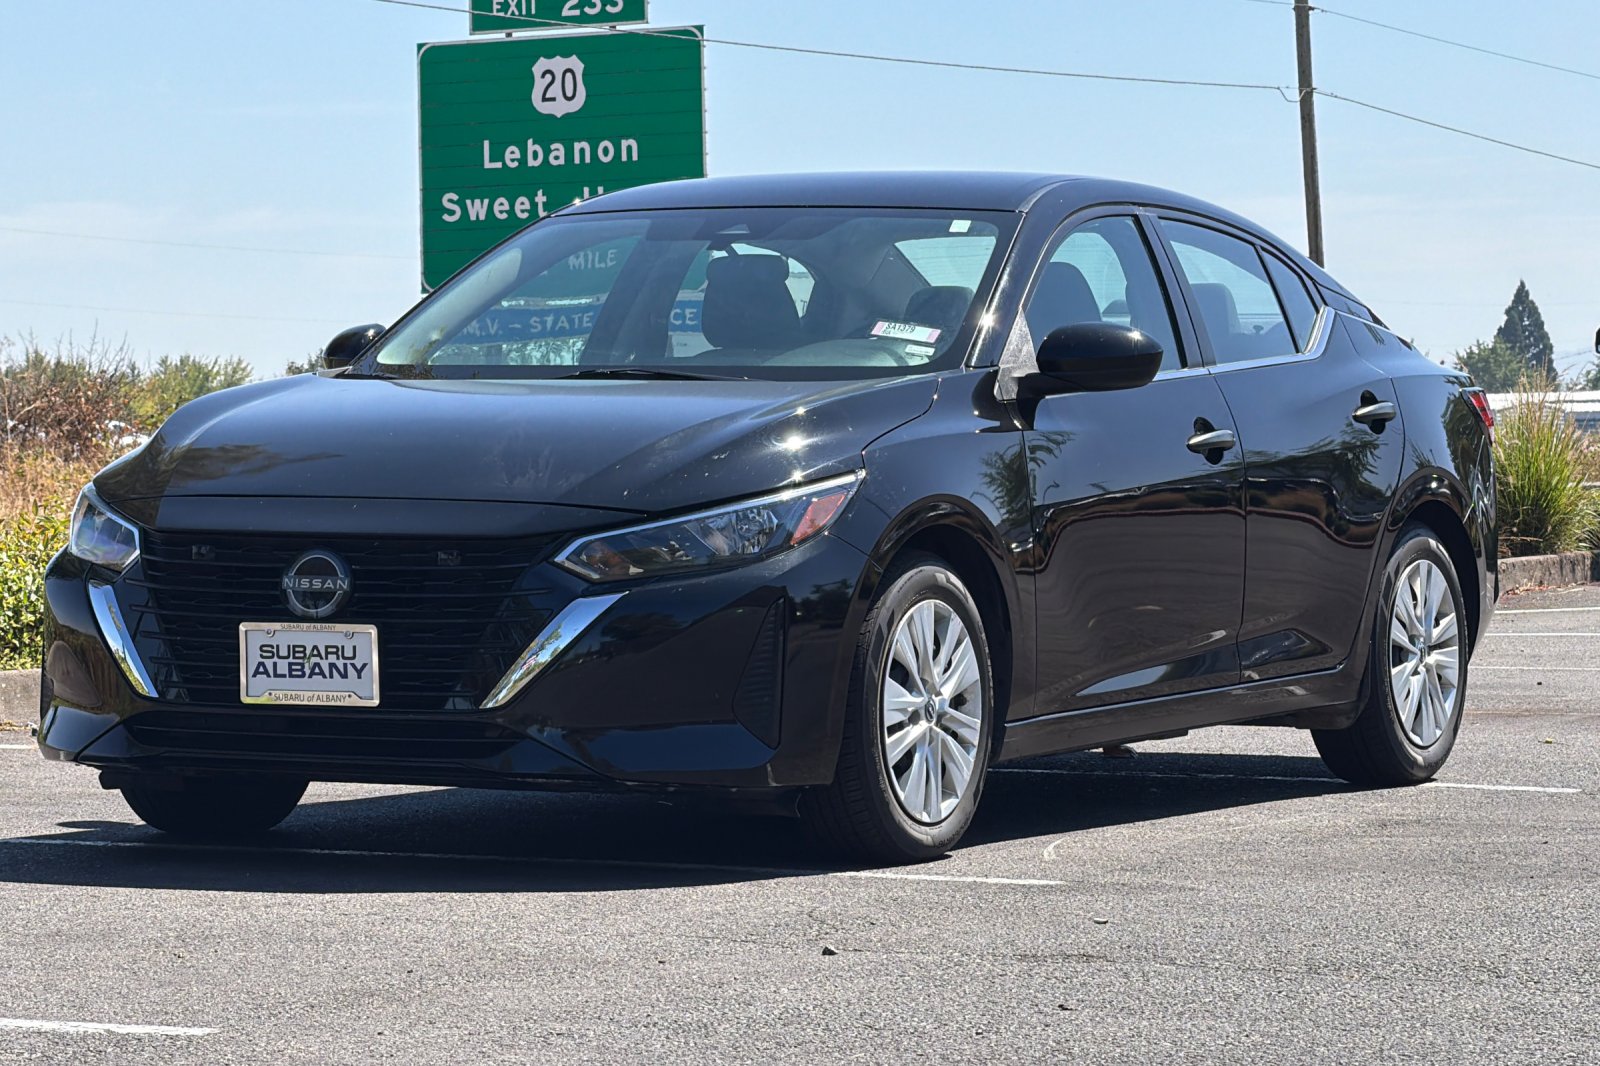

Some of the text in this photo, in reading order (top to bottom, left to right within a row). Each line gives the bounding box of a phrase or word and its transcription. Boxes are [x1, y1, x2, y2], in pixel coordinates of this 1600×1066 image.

[540, 67, 578, 103] 20
[483, 138, 639, 169] Lebanon
[441, 189, 548, 223] Sweet
[568, 249, 618, 270] MILE
[529, 311, 595, 333] STATE
[283, 578, 348, 590] NISSAN
[280, 623, 305, 631] SUBARU
[259, 644, 357, 661] SUBARU
[251, 661, 369, 680] ALBANY
[273, 692, 348, 704] SUBARU of ALBANY
